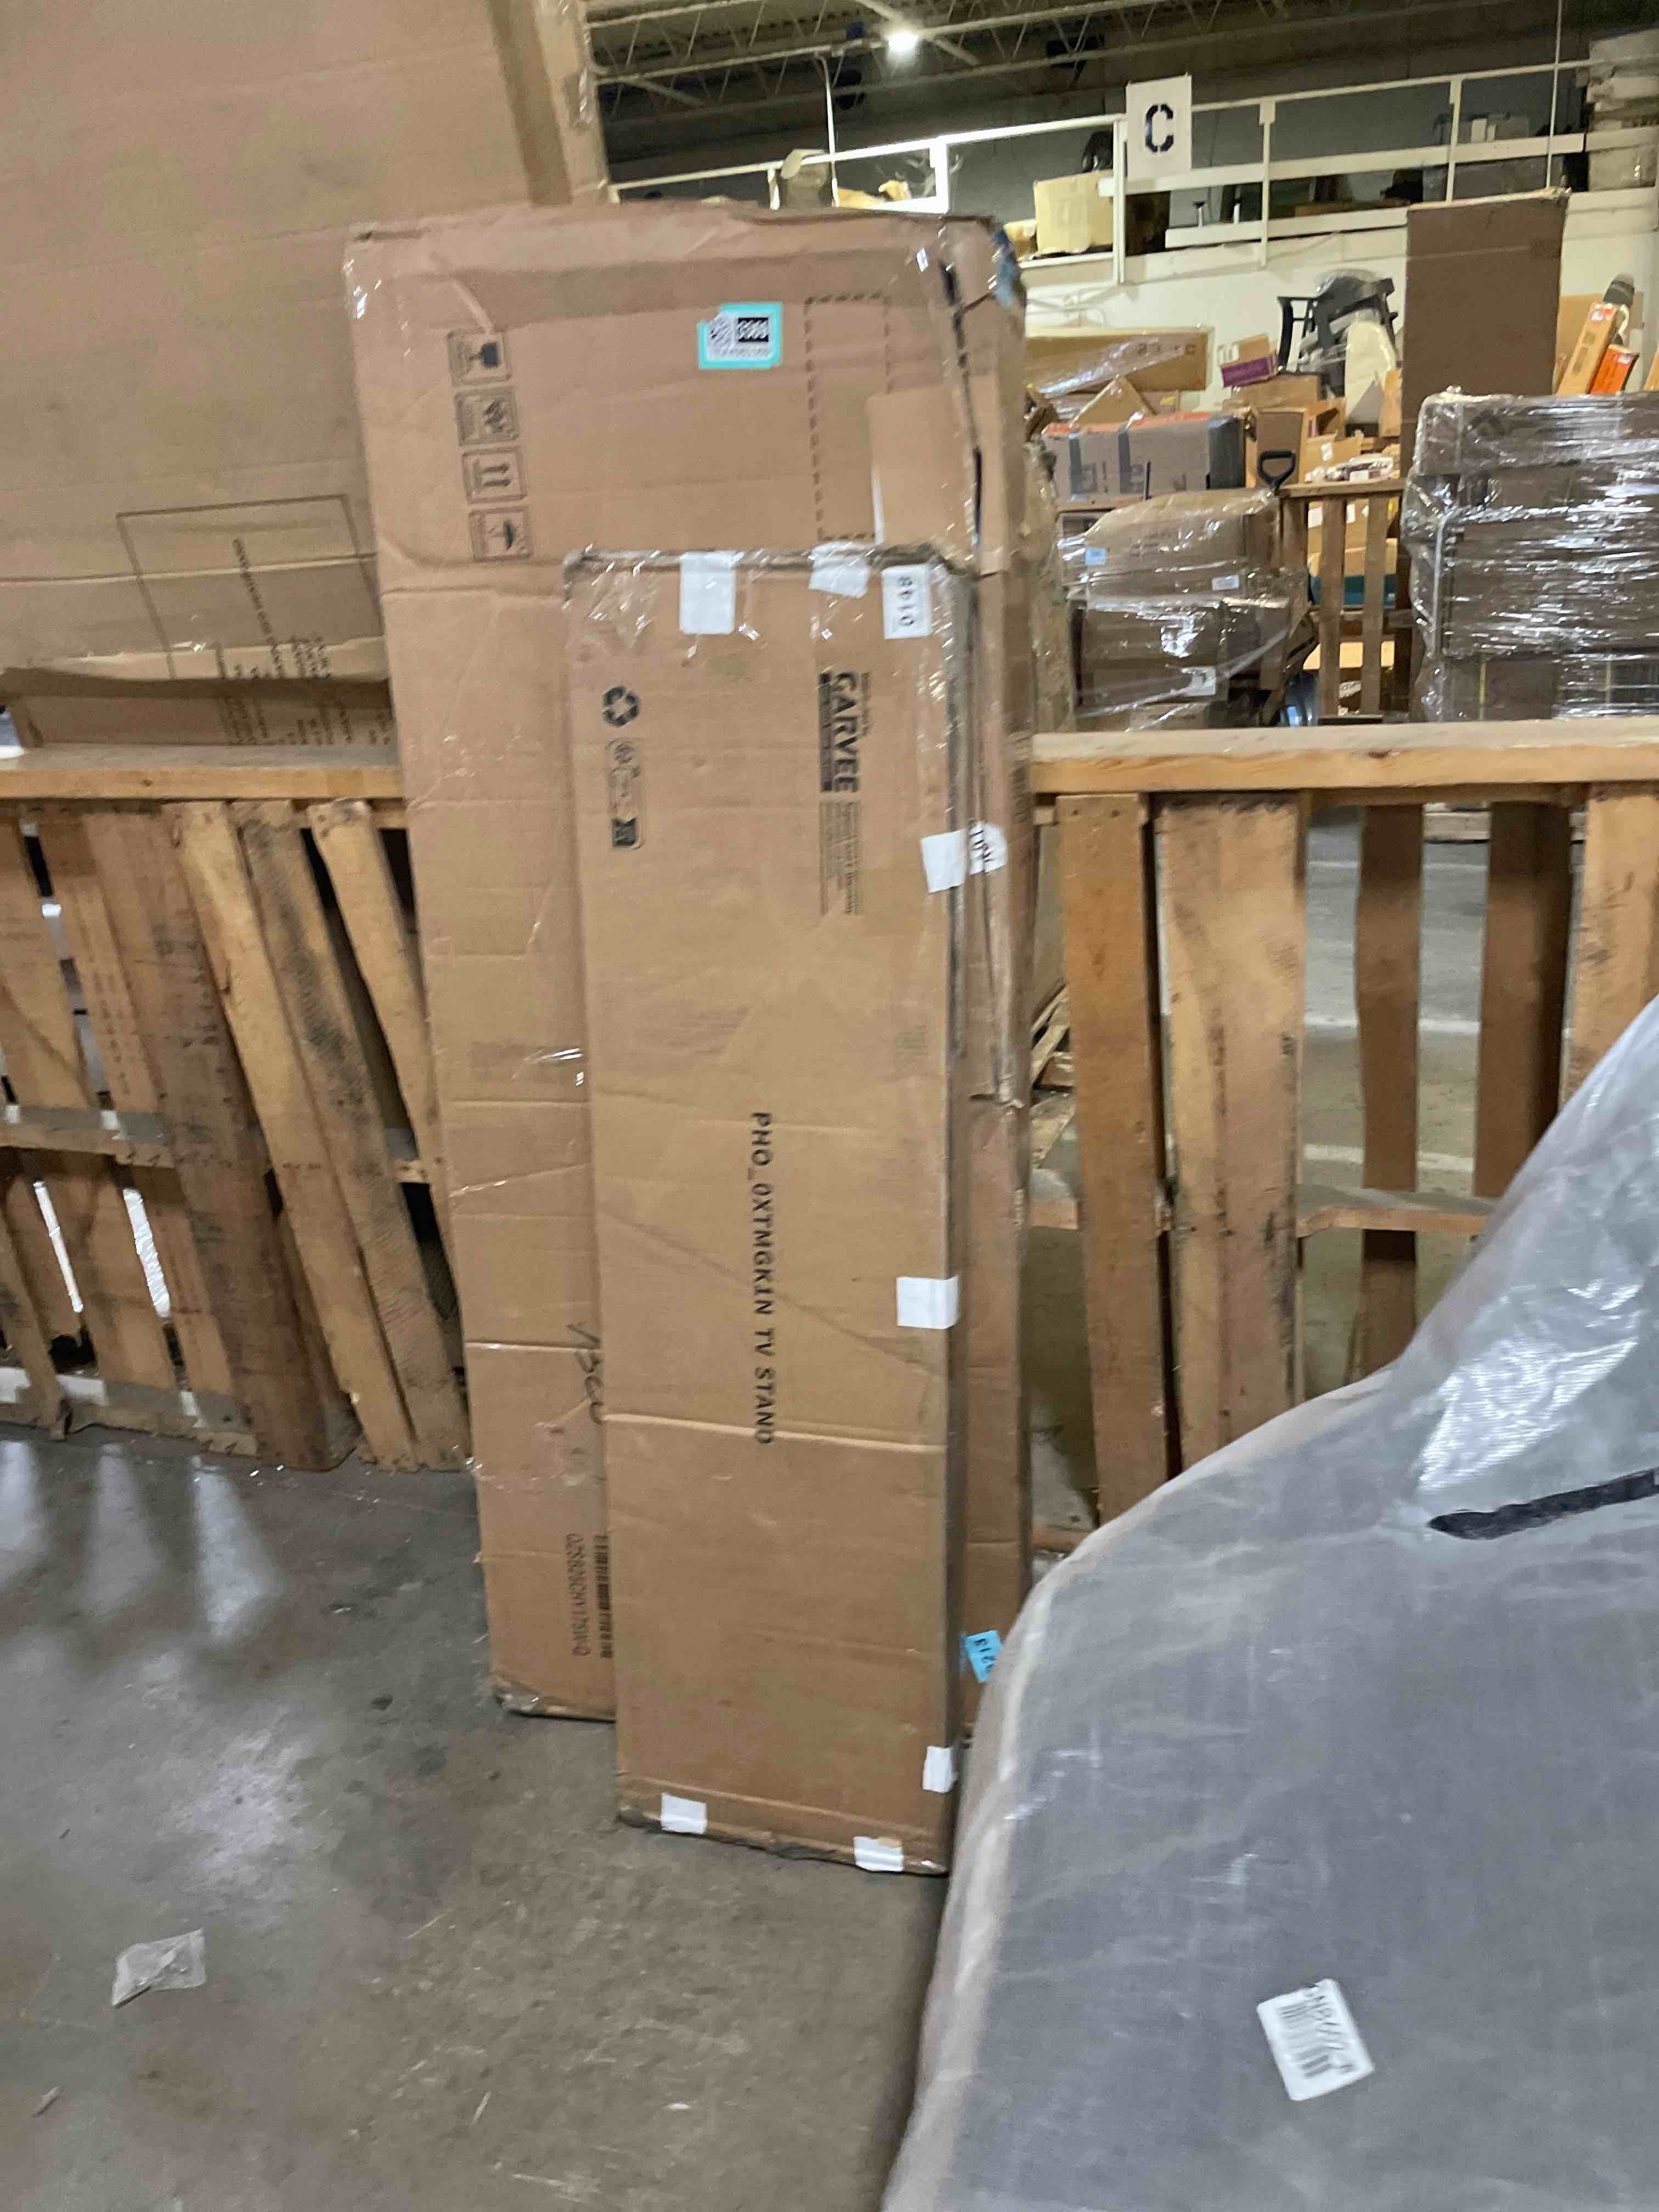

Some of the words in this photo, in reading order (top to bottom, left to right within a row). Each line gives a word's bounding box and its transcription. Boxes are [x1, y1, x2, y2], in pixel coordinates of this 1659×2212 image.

[1145, 104, 1174, 153] C
[832, 672, 860, 793] GARVEE
[754, 1327, 775, 1357] TV
[754, 1367, 776, 1445] STAND
